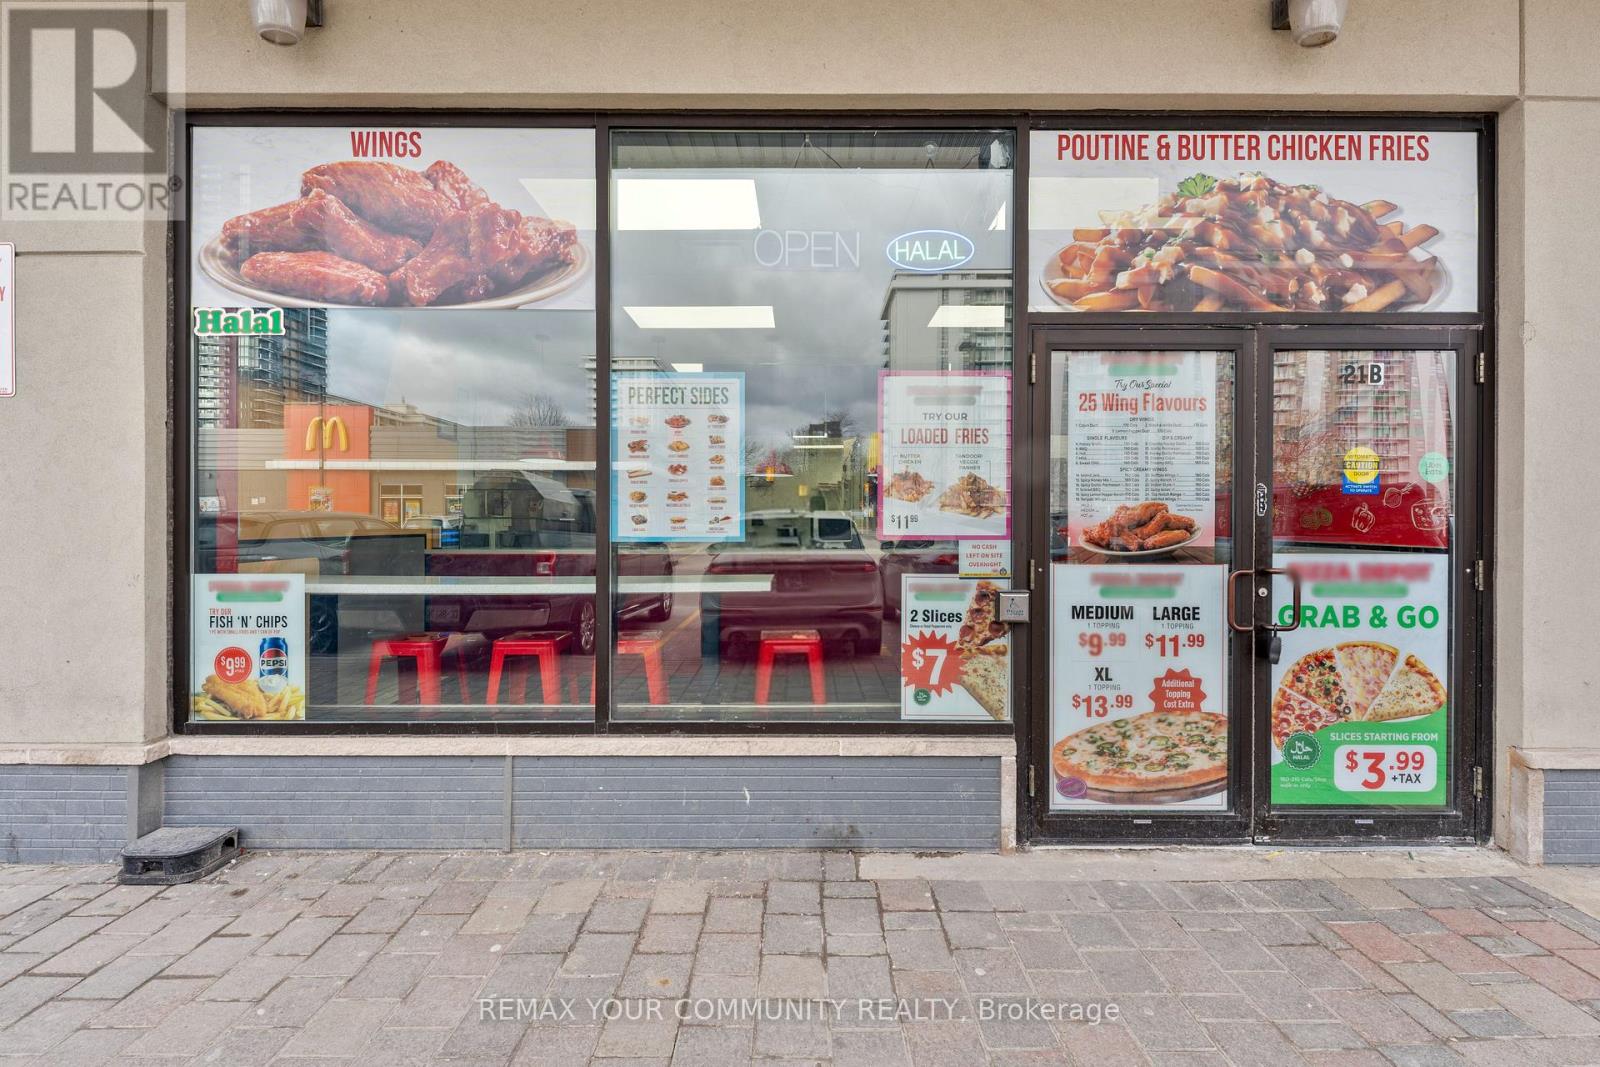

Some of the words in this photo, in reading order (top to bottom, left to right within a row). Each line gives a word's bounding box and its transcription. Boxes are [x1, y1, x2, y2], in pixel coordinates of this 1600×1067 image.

[350, 131, 422, 159] WINGS
[1057, 134, 1149, 161] POUTINE
[1156, 134, 1171, 161] &
[1178, 134, 1262, 162] BUTTER
[1267, 134, 1362, 162] CHICKEN
[1368, 134, 1430, 162] FRIES
[753, 229, 860, 269] OPEN
[895, 239, 966, 262] HALAL
[197, 309, 285, 336] Halal
[1343, 364, 1382, 384] 21B
[628, 387, 687, 405] PERFECT
[690, 387, 729, 405] SIDES
[1079, 393, 1097, 412] 25
[1102, 392, 1139, 415] Wing
[1142, 393, 1207, 412] Flavours
[922, 412, 942, 420] TRY
[944, 412, 968, 420] OUR
[900, 428, 948, 445] LOADED
[955, 428, 989, 444] FRIES
[1345, 461, 1379, 469] CAUTION
[910, 609, 918, 622] 2
[922, 609, 963, 623] Slices
[1071, 605, 1134, 620] MEDIUM
[1152, 606, 1201, 621] LARGE
[1278, 604, 1361, 628] GRAB
[1369, 605, 1388, 629] &
[1397, 605, 1439, 629] GO
[209, 615, 233, 628] FISH
[256, 615, 288, 628] CHIPS
[1078, 632, 1126, 656] $9.99
[1145, 633, 1205, 657] $11.99
[261, 659, 287, 667] PEPSI
[912, 647, 948, 685] $7
[1094, 667, 1113, 681] XL
[1161, 679, 1195, 687] Additional
[1165, 690, 1191, 699] Topping
[1072, 694, 1133, 718] $13.99
[1163, 701, 1177, 709] Cost
[1178, 701, 1195, 709] Extra
[1330, 732, 1362, 741] SLICES
[1364, 732, 1409, 741] STARTING
[1411, 732, 1438, 742] FROM
[1345, 750, 1424, 790] $3.99
[1391, 773, 1421, 784] +TAX
